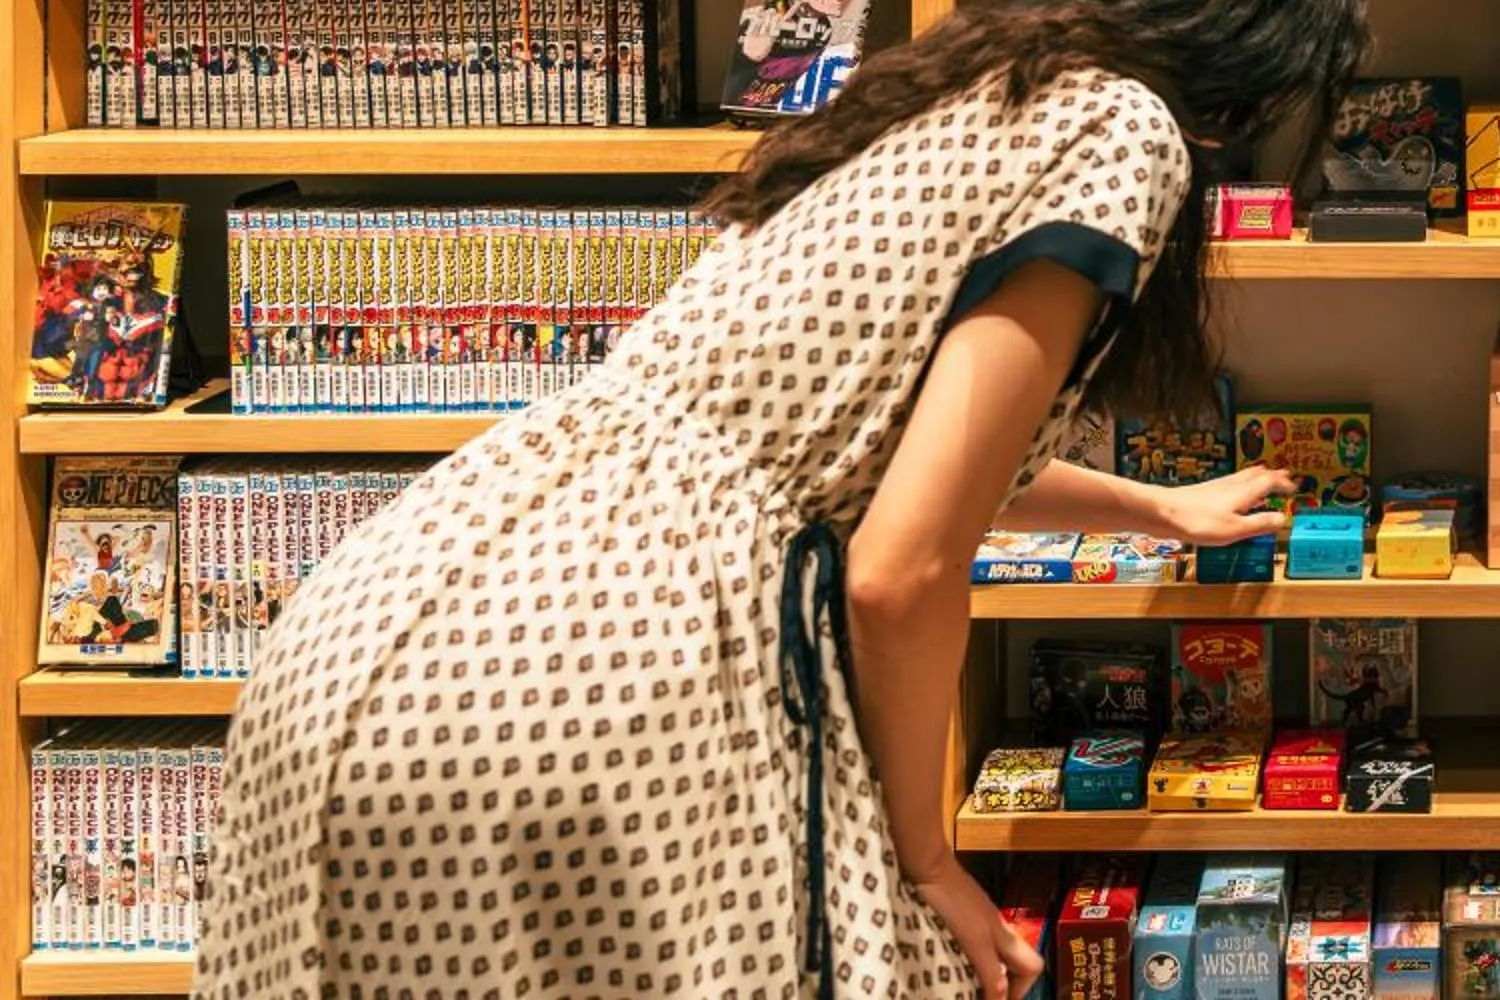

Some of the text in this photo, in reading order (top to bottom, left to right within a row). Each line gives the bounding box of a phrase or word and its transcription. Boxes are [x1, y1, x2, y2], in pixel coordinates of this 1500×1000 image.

[109, 31, 117, 46] 2
[121, 31, 131, 46] 3
[223, 31, 234, 46] 9
[239, 31, 251, 46] 10
[1099, 685, 1147, 711] 人狼
[1215, 936, 1256, 951] RATS OF
[1202, 952, 1271, 977] WISTAR
